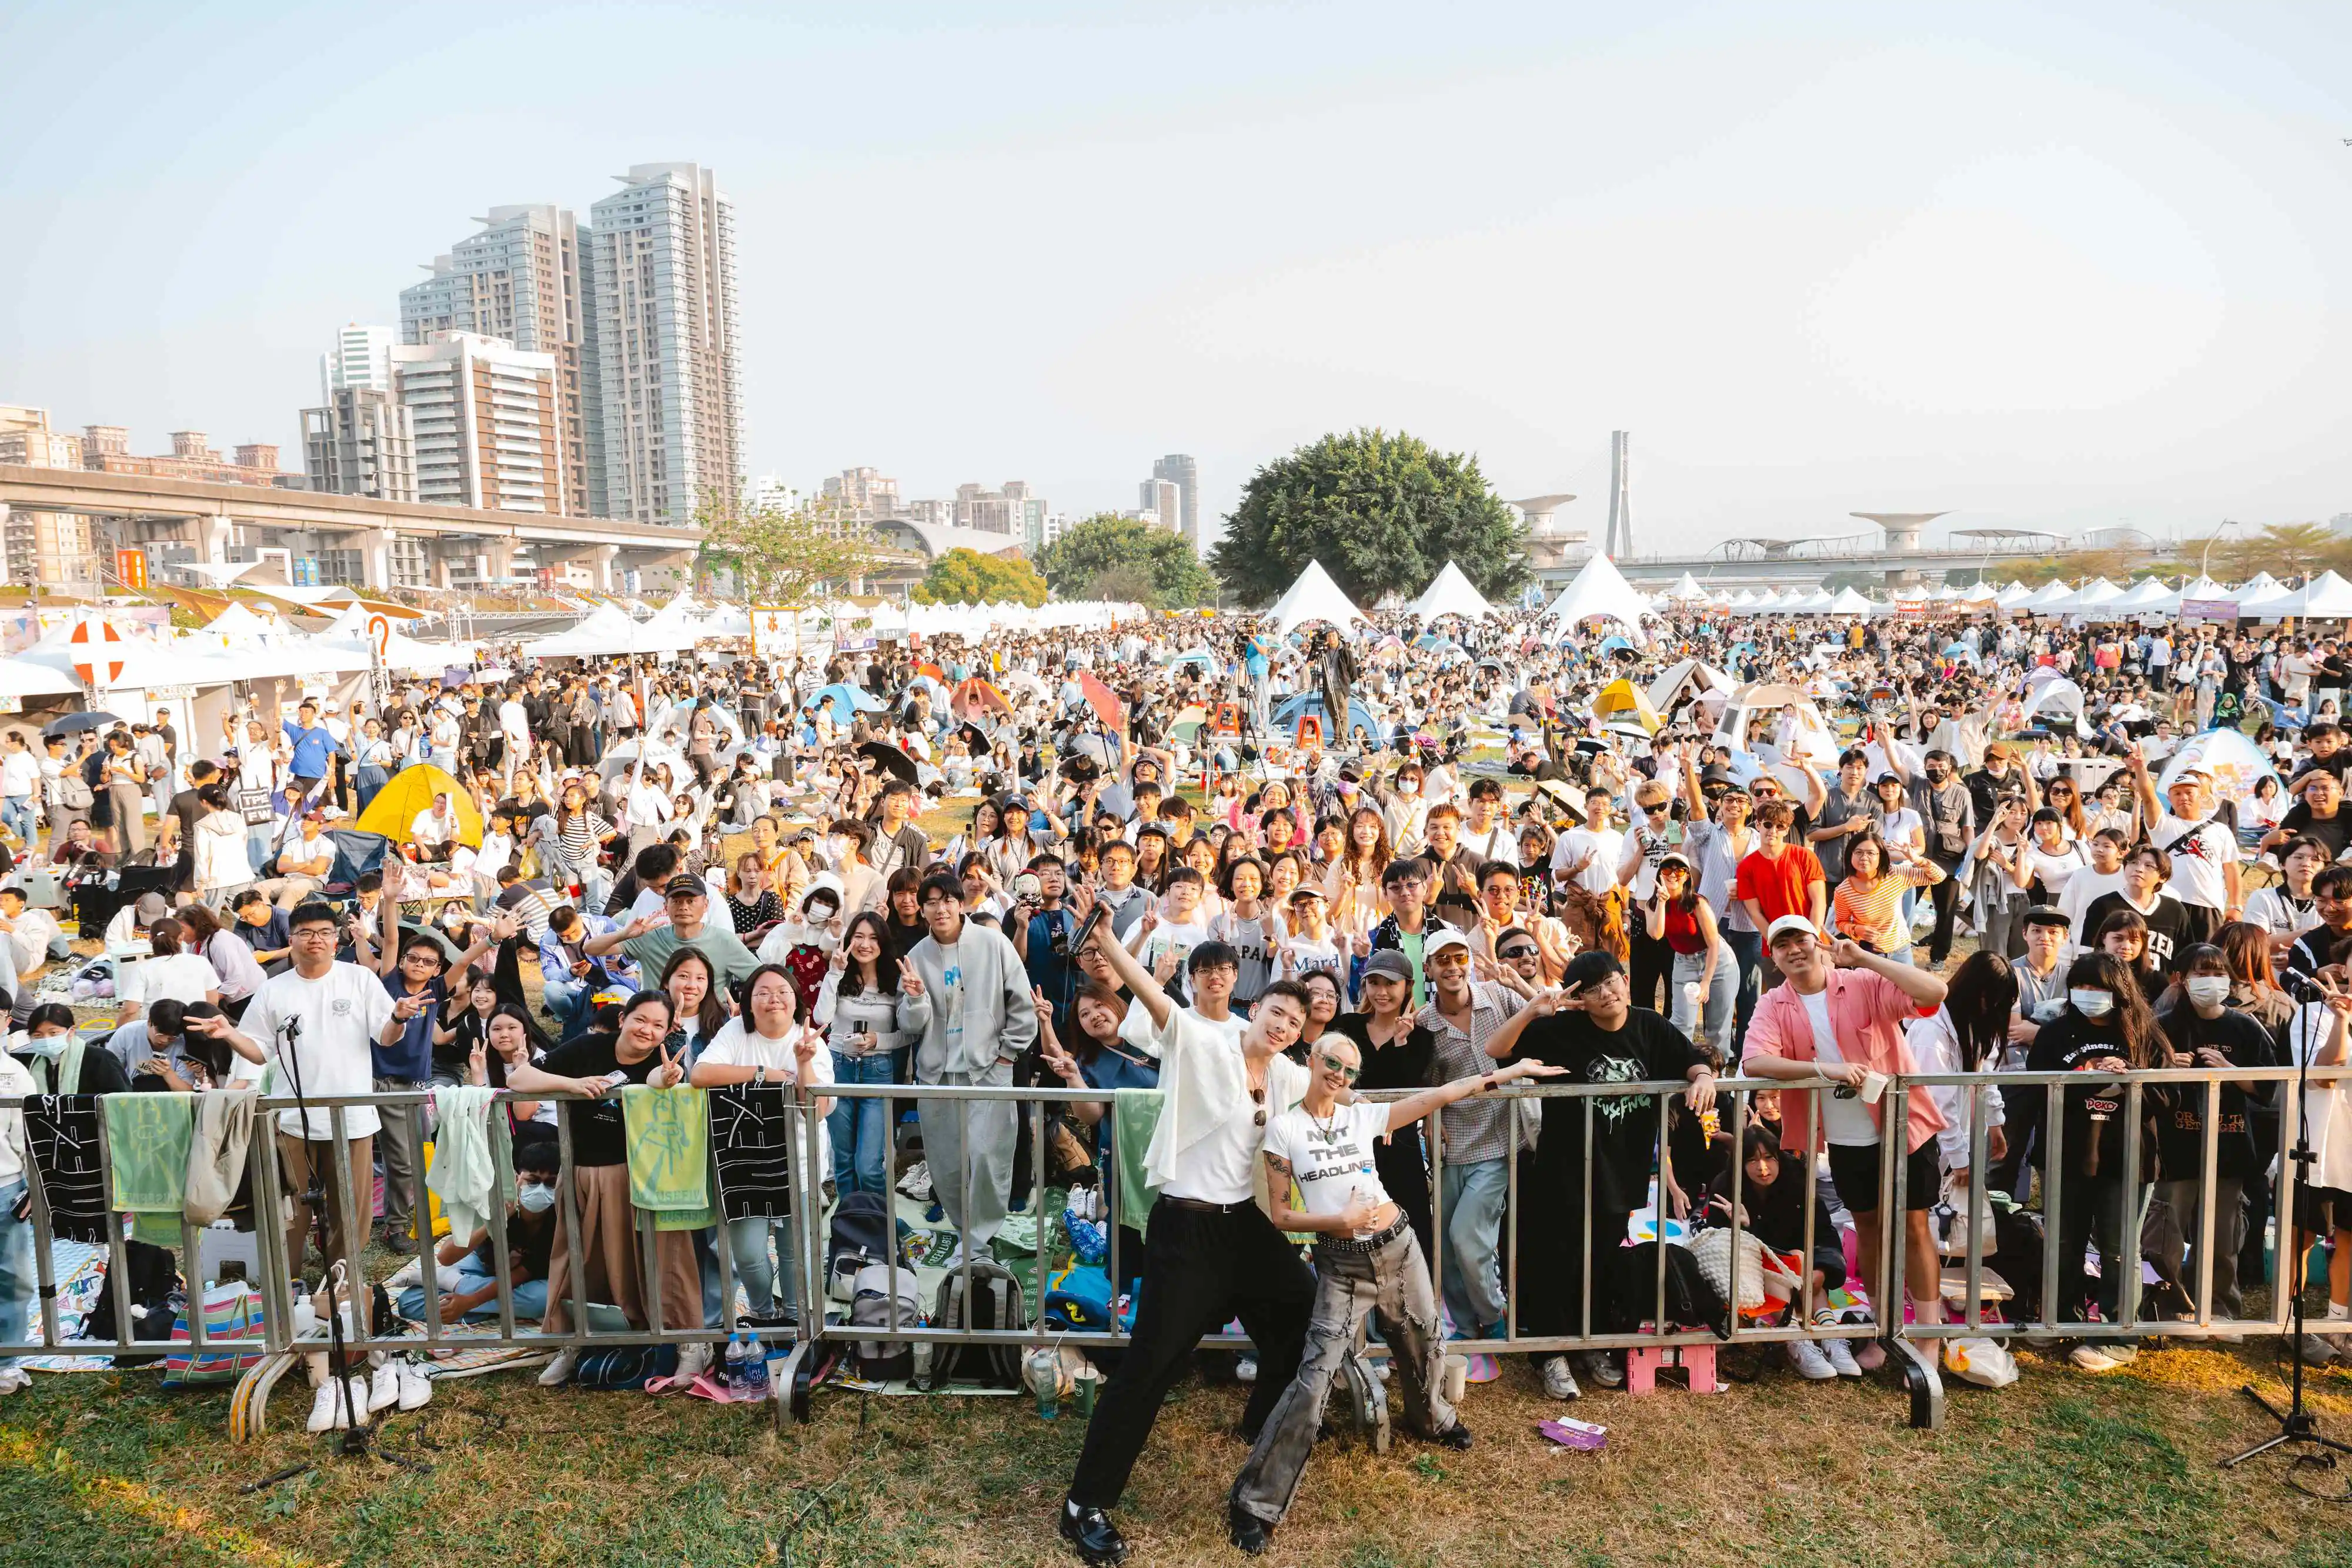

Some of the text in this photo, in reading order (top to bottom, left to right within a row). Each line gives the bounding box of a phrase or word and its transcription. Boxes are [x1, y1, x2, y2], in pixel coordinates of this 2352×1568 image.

[242, 794, 269, 805] TPE
[248, 810, 271, 822] FW
[1309, 1143, 1360, 1162] THE
[718, 1371, 730, 1382] FRE
